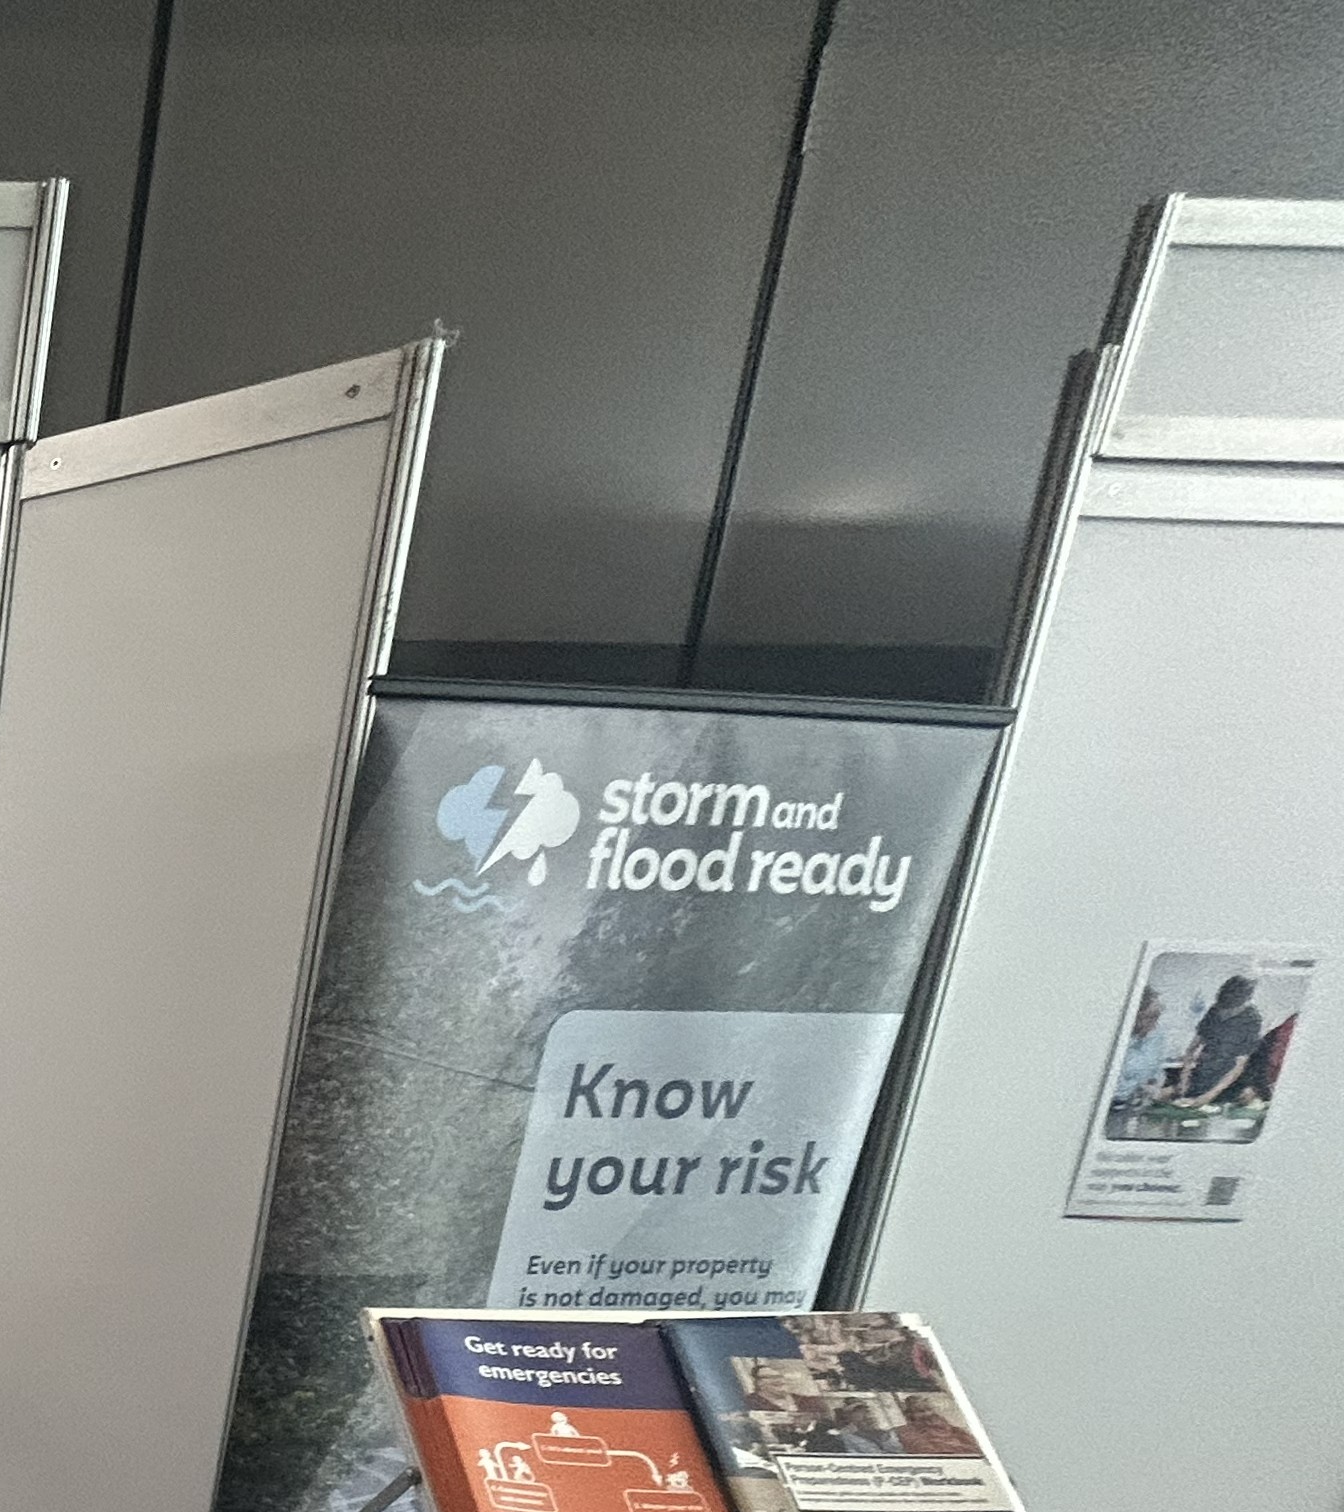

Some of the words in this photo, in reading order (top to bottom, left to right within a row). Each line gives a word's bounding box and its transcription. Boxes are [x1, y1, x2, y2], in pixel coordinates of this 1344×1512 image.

[599, 772, 770, 827] storm
[772, 792, 843, 830] and
[585, 828, 739, 892] flood
[750, 835, 912, 912] ready
[562, 1063, 754, 1121] Know
[543, 1155, 704, 1211] your
[715, 1139, 829, 1196] risk
[526, 1255, 581, 1275] Even
[587, 1254, 607, 1279] if
[609, 1259, 666, 1279] your
[670, 1258, 774, 1279] property
[518, 1286, 538, 1307] is
[544, 1289, 584, 1307] not
[588, 1286, 707, 1310] damaged,
[713, 1290, 758, 1311] you
[464, 1336, 508, 1356] Get
[511, 1342, 576, 1363] ready
[581, 1341, 618, 1359] for
[478, 1365, 623, 1387] emergencies
